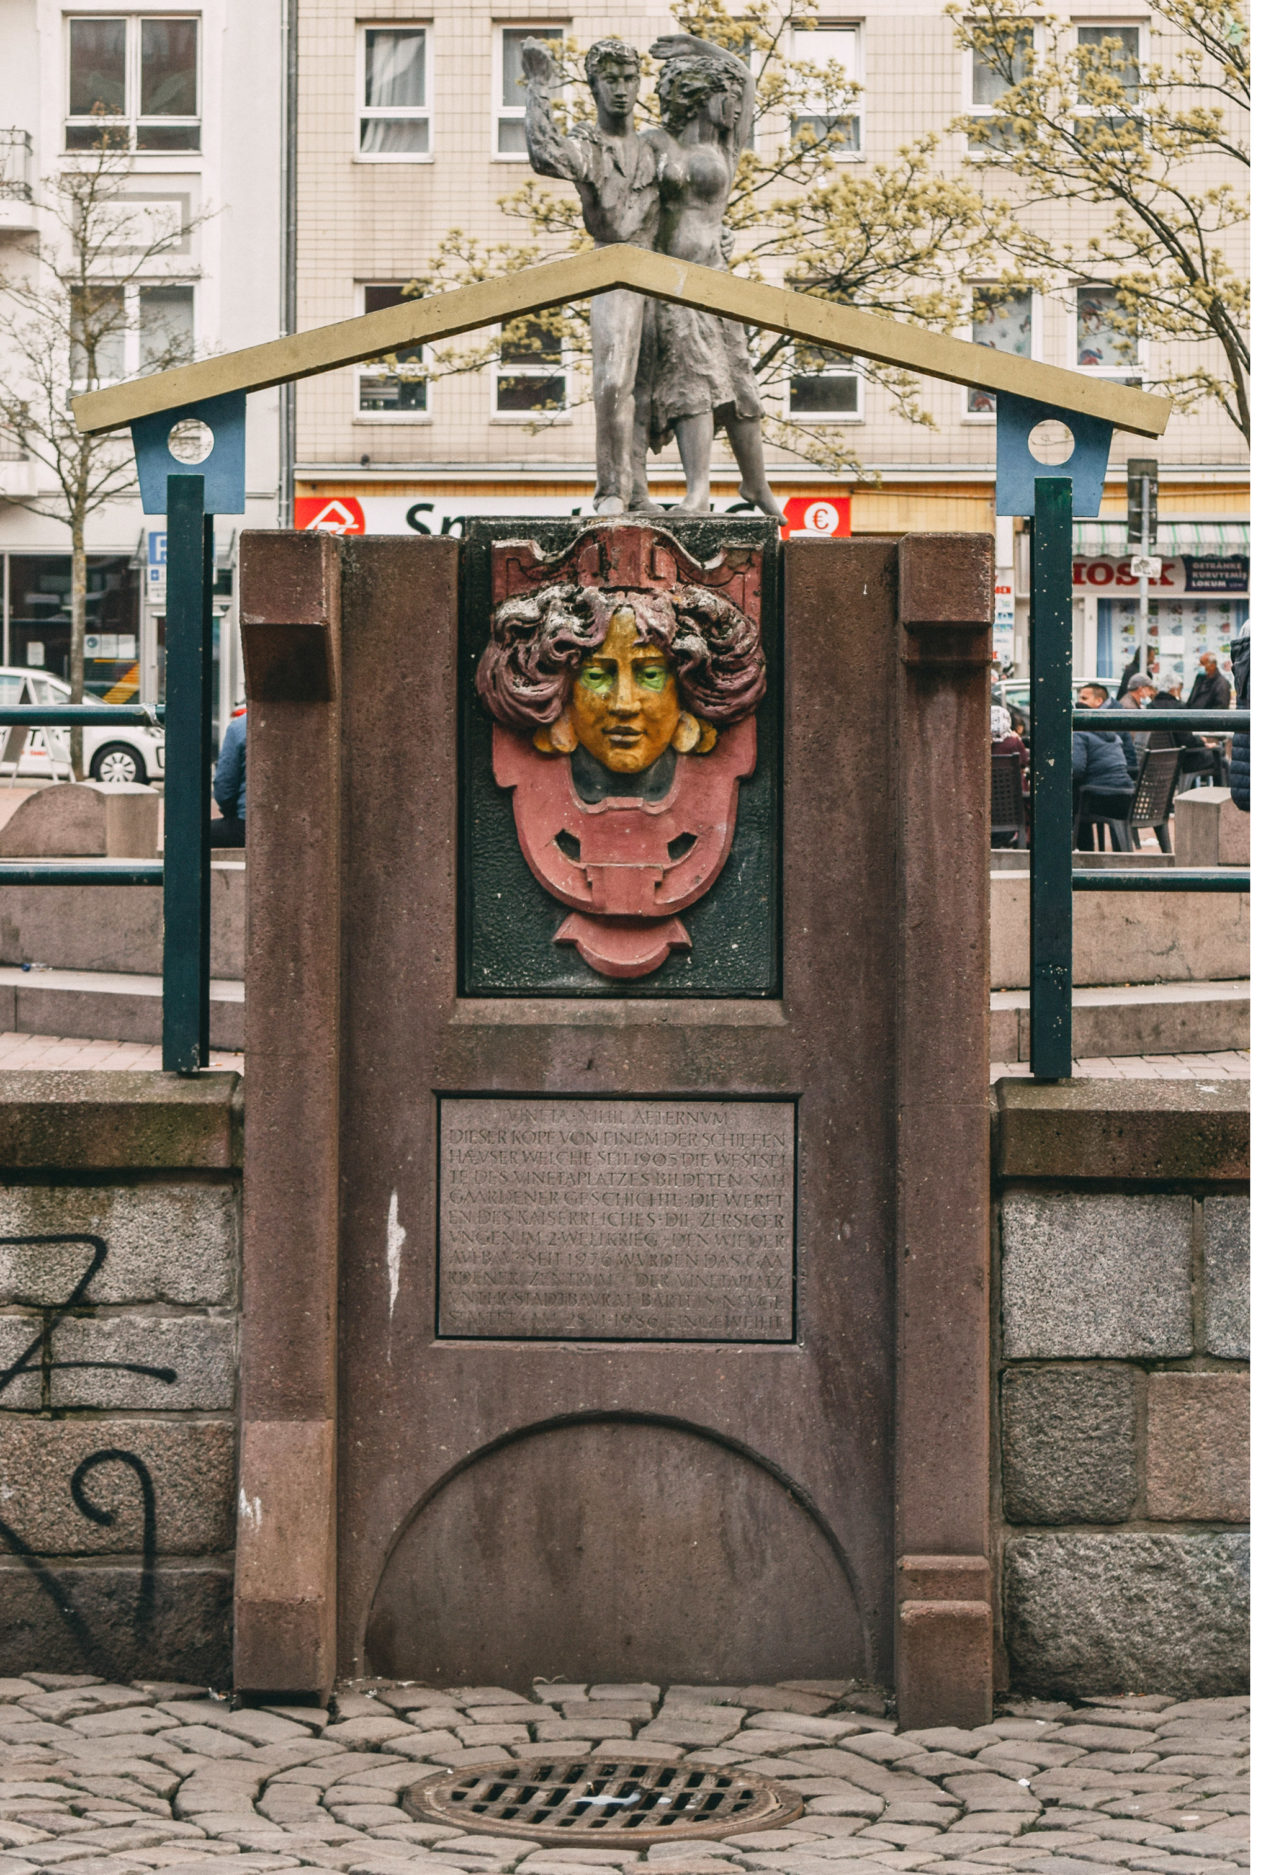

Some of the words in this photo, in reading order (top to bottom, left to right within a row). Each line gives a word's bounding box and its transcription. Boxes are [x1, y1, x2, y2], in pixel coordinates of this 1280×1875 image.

[1072, 562, 1175, 586] IOSK
[1191, 580, 1226, 588] LOKUM
[448, 1129, 507, 1146] DIESER
[510, 1129, 556, 1146] KOPF
[557, 1129, 599, 1146] VON
[602, 1129, 659, 1146] EINEM
[661, 1129, 698, 1146] DER
[520, 1149, 593, 1168] WELCHE
[595, 1149, 631, 1168] SEIT
[634, 1149, 678, 1168] 1905
[681, 1149, 712, 1168] DIE
[448, 1170, 469, 1188] TE
[474, 1170, 508, 1188] DES
[511, 1170, 651, 1188] VINETAPLATZES
[653, 1170, 743, 1188] BILDETEN
[448, 1190, 558, 1209] GAARDENER
[688, 1190, 722, 1209] DIE
[723, 1190, 785, 1209] WERFT
[448, 1210, 472, 1228] EN
[477, 1210, 513, 1228] DES
[664, 1210, 694, 1228] DIE
[448, 1230, 515, 1248] VNGEN
[519, 1230, 541, 1248] IM
[670, 1230, 710, 1248] DEN
[526, 1250, 560, 1268] SEIT
[567, 1250, 611, 1268] 1976
[701, 1250, 739, 1268] DAS
[634, 1271, 670, 1289] DER
